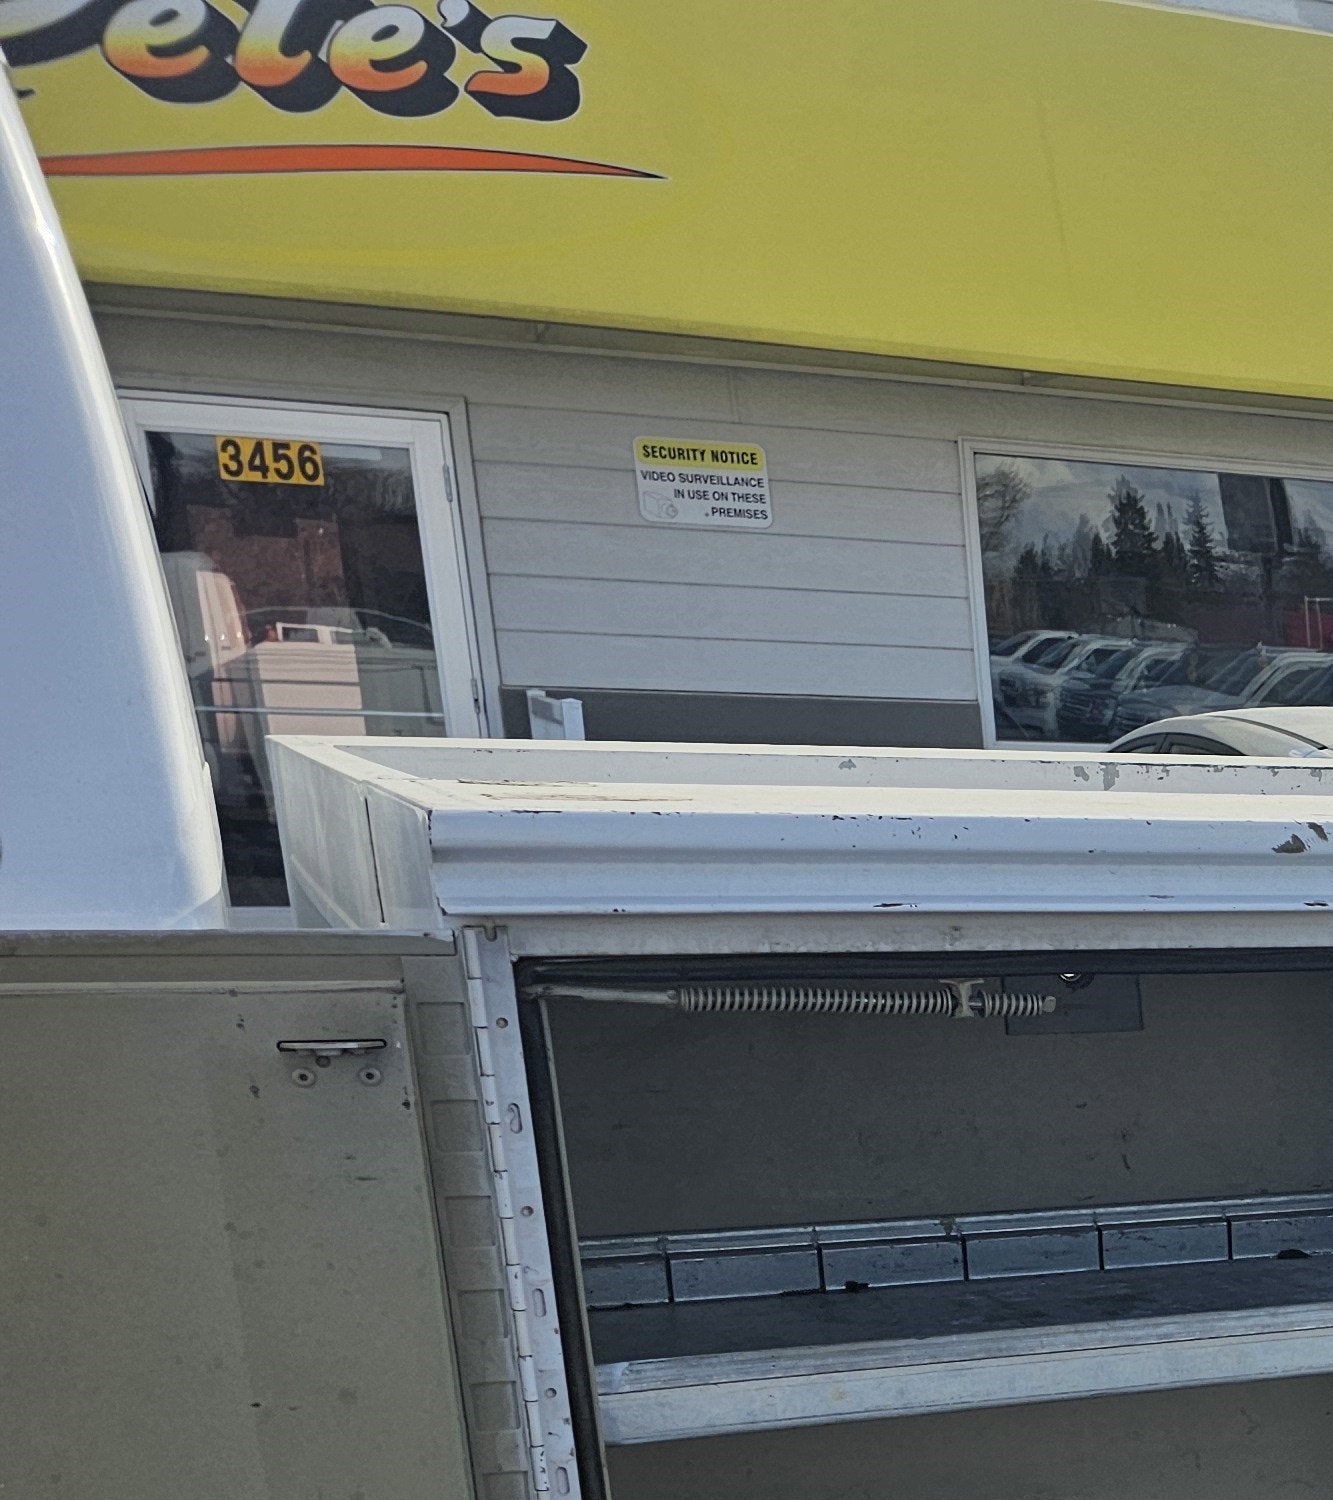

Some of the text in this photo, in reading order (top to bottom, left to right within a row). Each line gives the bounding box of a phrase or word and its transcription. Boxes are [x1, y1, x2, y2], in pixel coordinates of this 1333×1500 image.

[221, 439, 320, 482] 3456
[642, 445, 758, 466] SECURITY NOTICE
[640, 470, 764, 488] VIDEO SURVEILLANCE
[673, 488, 766, 504] IN USE ON THESE
[711, 507, 768, 520] PREMISES
